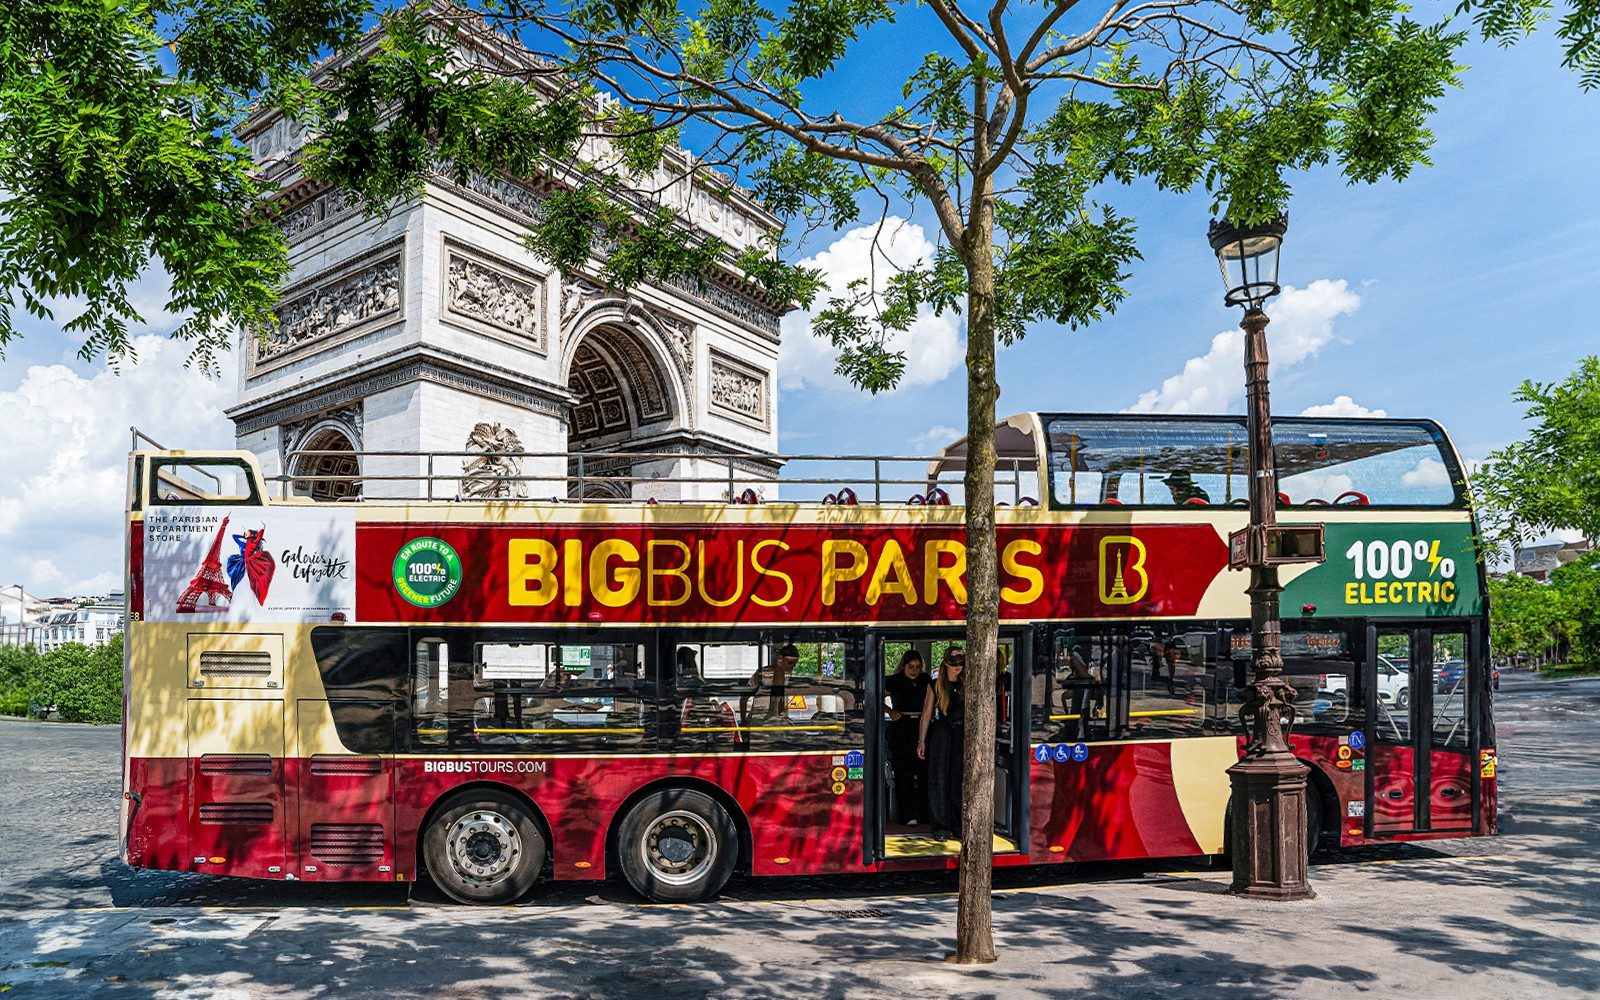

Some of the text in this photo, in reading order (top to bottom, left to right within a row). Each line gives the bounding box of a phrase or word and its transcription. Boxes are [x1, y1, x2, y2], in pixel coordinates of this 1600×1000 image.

[149, 525, 214, 533] DEPARTMENT
[149, 534, 181, 542] STORE
[281, 545, 327, 567] Galeries
[400, 548, 412, 560] EN
[411, 541, 438, 552] ROUTE
[439, 544, 449, 555] TO
[1345, 539, 1456, 580] 100%
[293, 557, 350, 583] Lafayette
[409, 562, 446, 575] 100%
[821, 538, 1045, 606] PARS
[397, 577, 429, 604] GREENER
[430, 578, 457, 604] FUTURE
[1344, 580, 1456, 605] ELECTRIC
[424, 761, 547, 773] BIGBUSTOURS.COM
